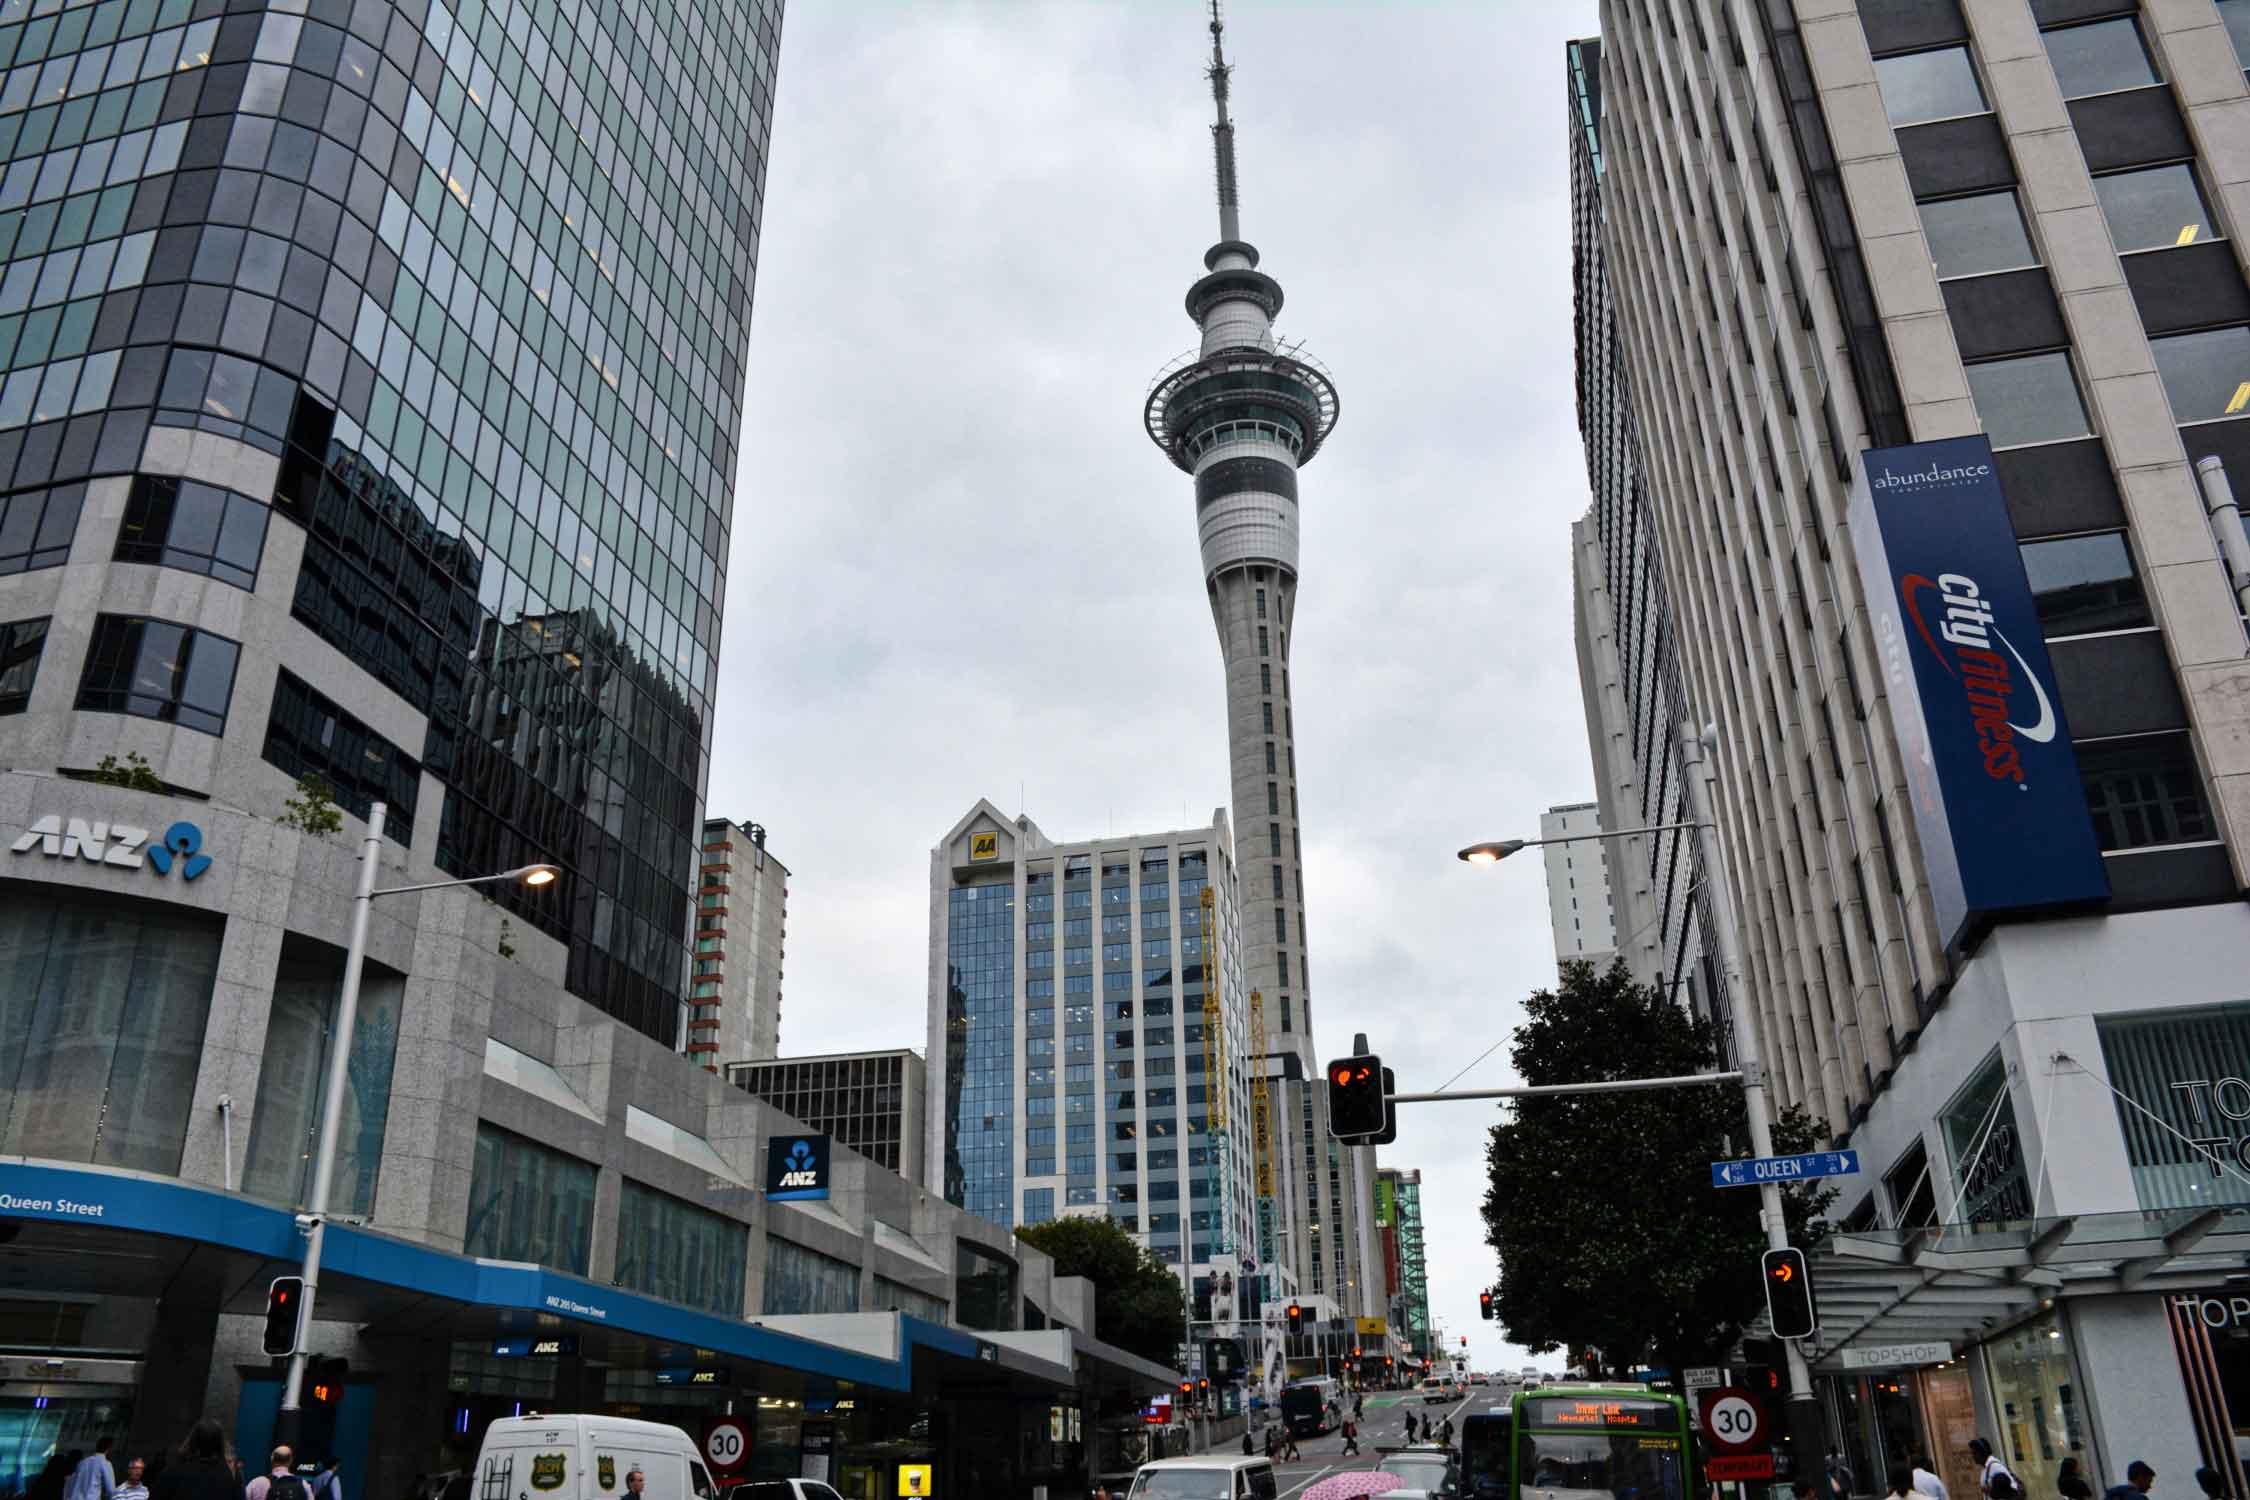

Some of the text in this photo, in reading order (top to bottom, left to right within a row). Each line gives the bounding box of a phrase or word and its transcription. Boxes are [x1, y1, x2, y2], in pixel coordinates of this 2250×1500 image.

[1875, 463, 1989, 488] abundance
[10, 815, 149, 868] ANZ
[975, 839, 996, 852] AA
[1755, 1160, 1802, 1178] QUEEN
[779, 1171, 816, 1186] ANZ
[0, 1194, 104, 1216] Queen Street
[534, 1342, 559, 1353] ANZ
[1857, 1347, 1937, 1367] TOPSHOP
[693, 1373, 715, 1382] ANZ
[836, 1400, 855, 1408] ANZ
[1576, 1402, 1621, 1415] Inner Link
[1718, 1409, 1752, 1434] 30
[711, 1435, 739, 1456] 30
